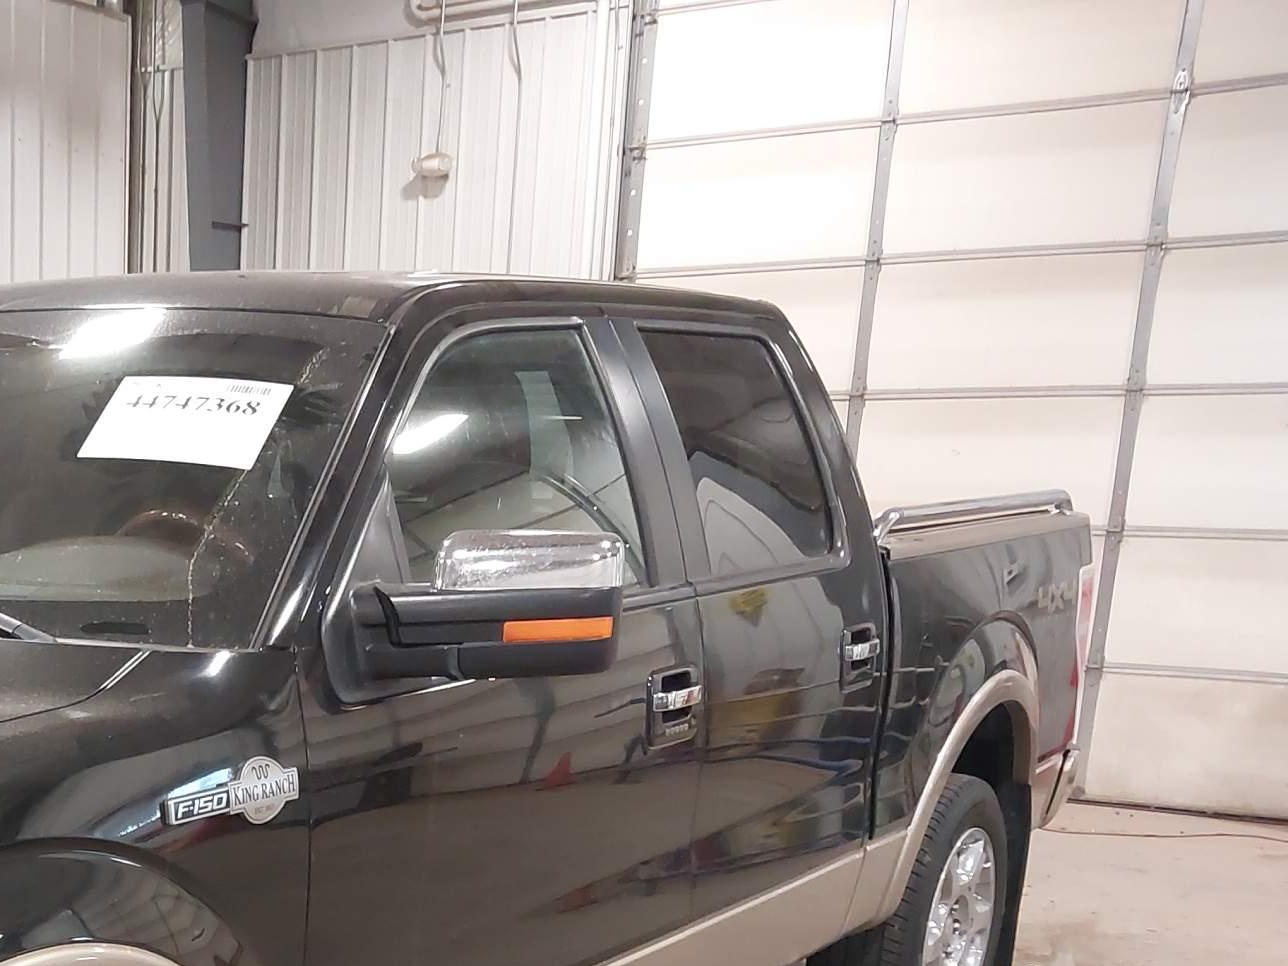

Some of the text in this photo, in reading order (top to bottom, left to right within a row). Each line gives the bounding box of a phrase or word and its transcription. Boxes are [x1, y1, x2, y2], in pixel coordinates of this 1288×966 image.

[125, 394, 261, 415] 44747368
[232, 773, 295, 806] KING RANCH
[176, 792, 228, 819] F-150
